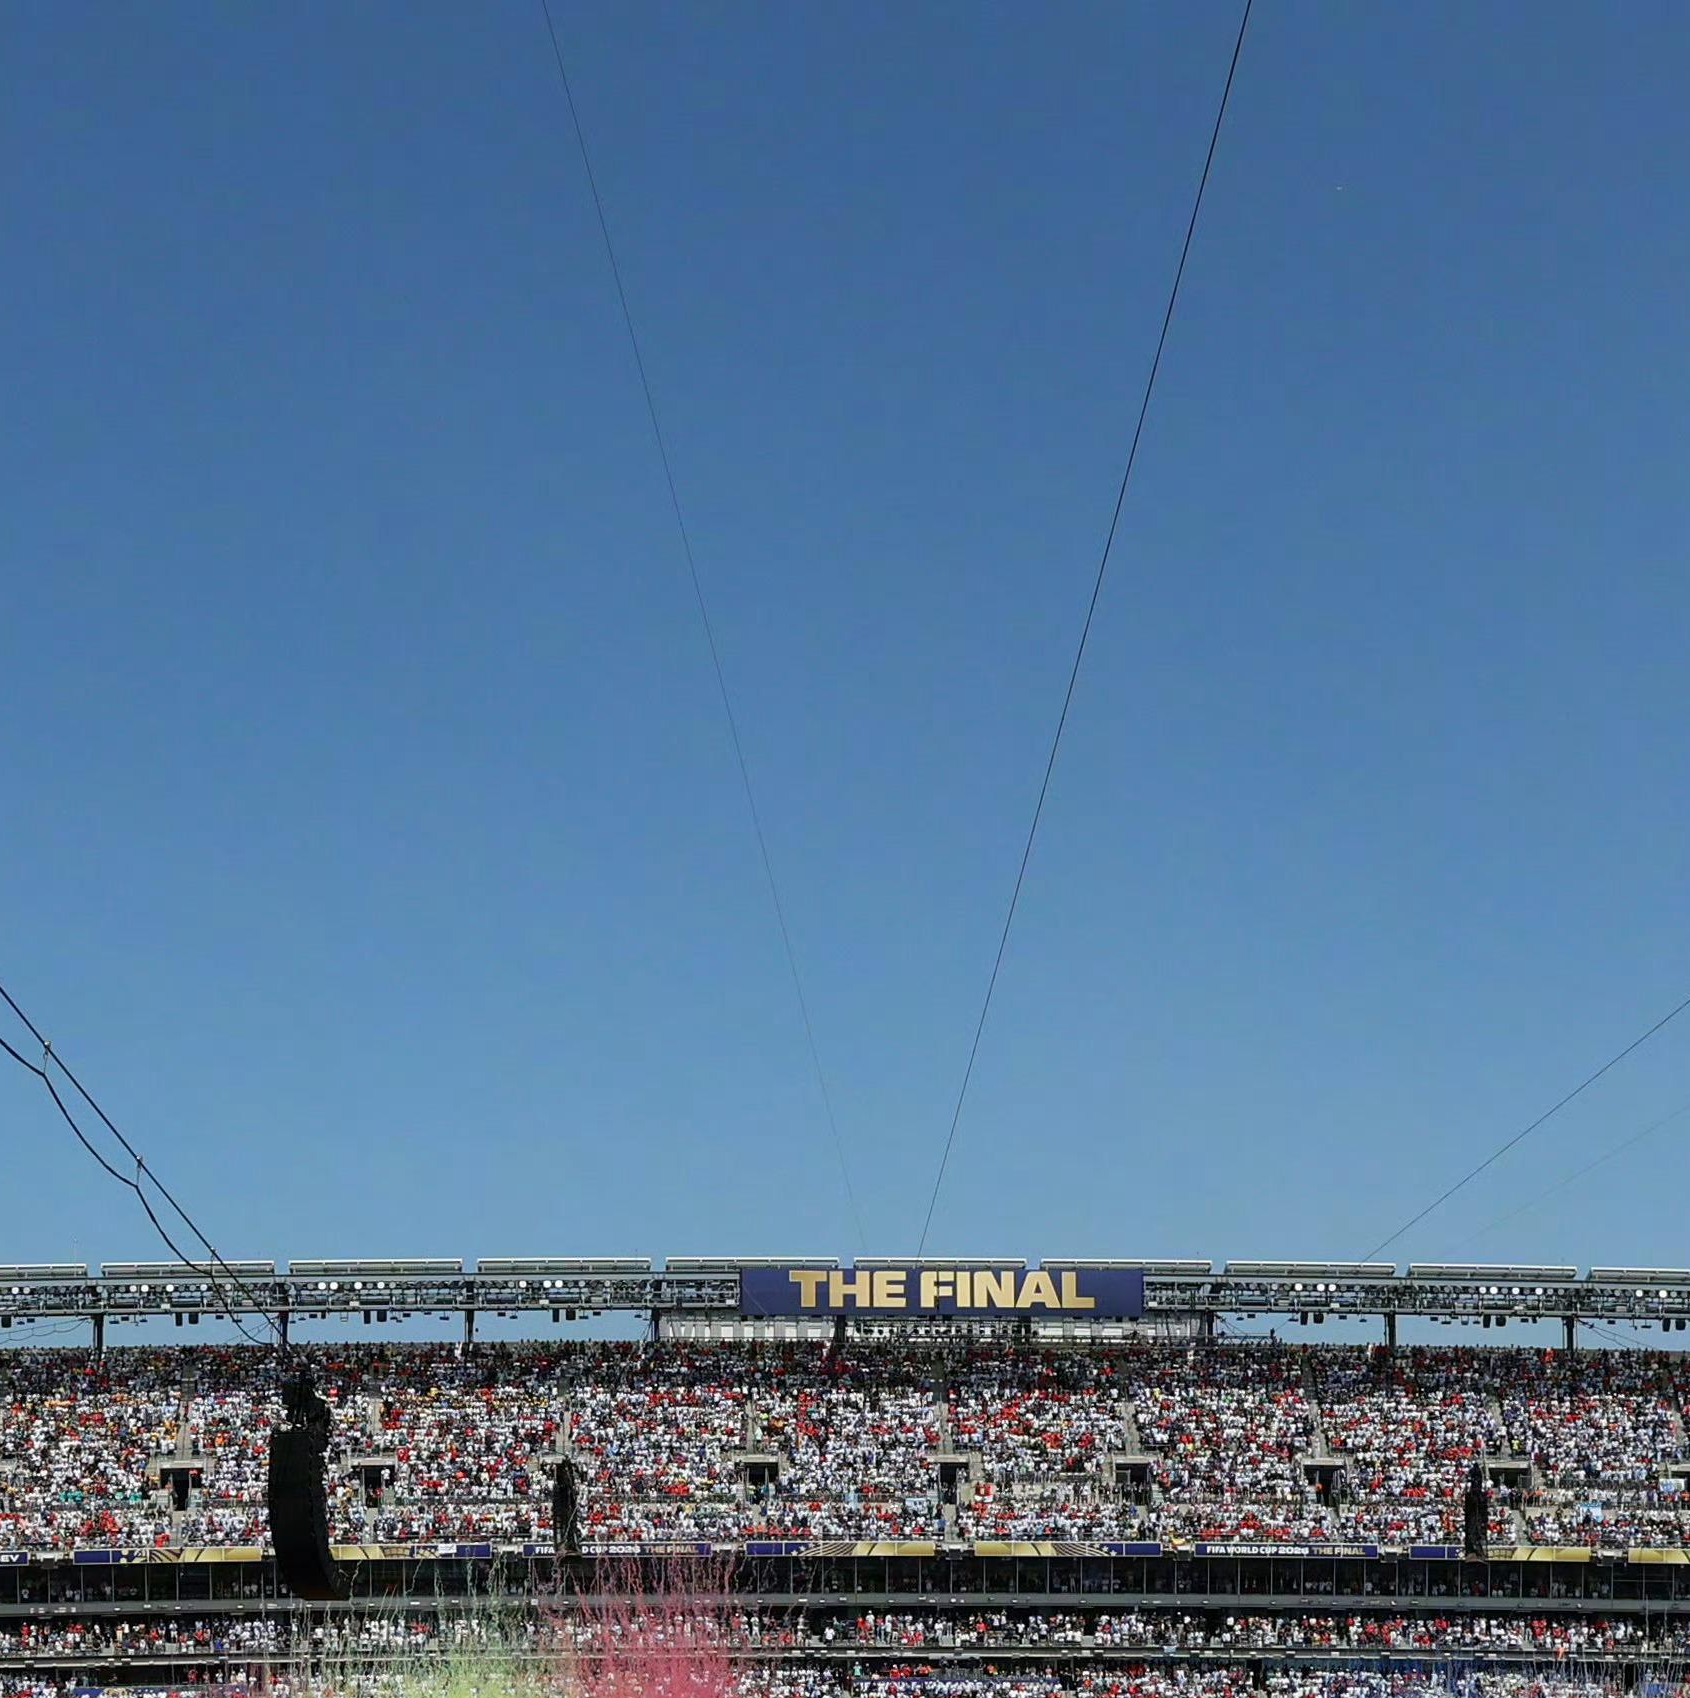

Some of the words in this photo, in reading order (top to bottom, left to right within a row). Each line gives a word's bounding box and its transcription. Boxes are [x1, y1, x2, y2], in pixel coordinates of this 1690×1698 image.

[789, 1270, 907, 1309] THE
[919, 1270, 1096, 1309] FINAL
[1206, 1545, 1226, 1554] FIFA
[1226, 1546, 1259, 1554] WORLD
[1259, 1546, 1277, 1554] CUP
[1277, 1546, 1309, 1555] 2026
[1311, 1547, 1333, 1555] THE
[1334, 1547, 1366, 1555] FINAL
